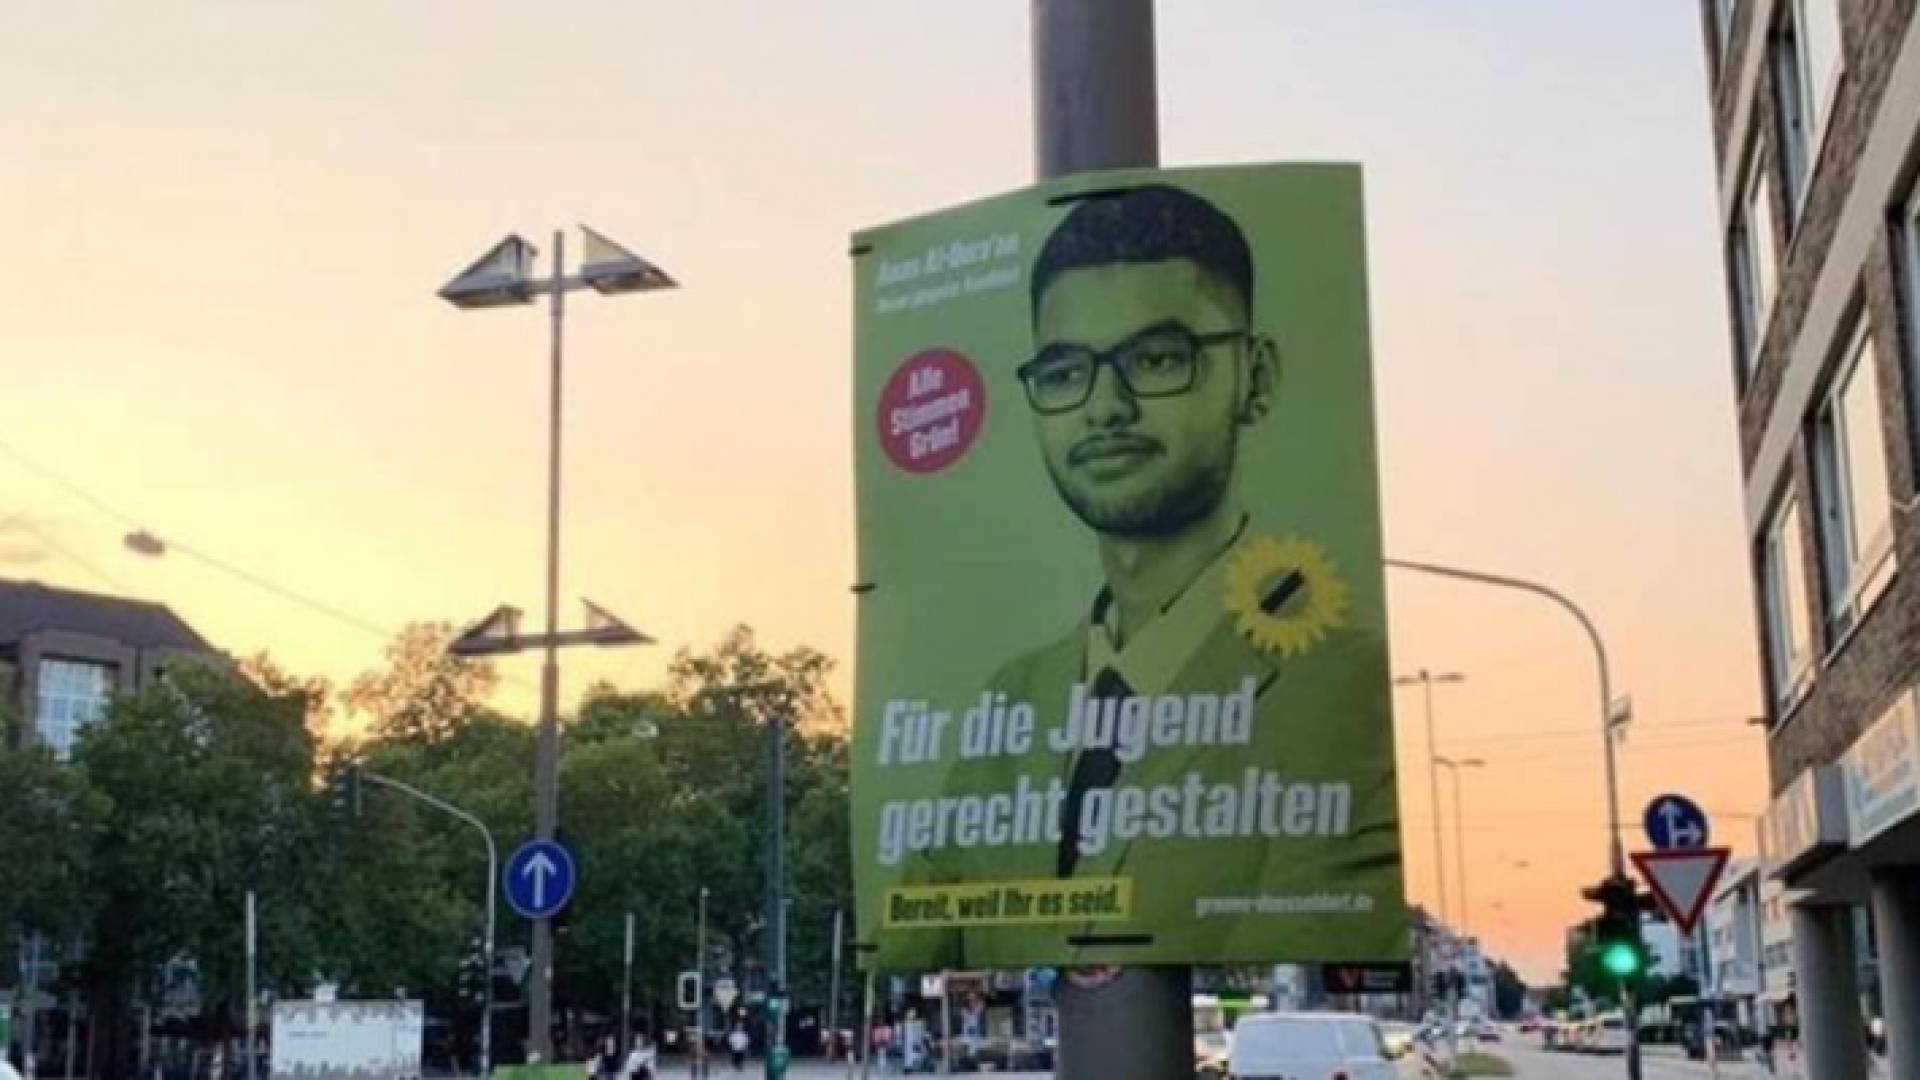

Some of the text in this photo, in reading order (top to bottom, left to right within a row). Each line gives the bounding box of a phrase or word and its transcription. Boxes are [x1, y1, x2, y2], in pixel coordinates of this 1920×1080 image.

[909, 366, 944, 399] Alle
[890, 388, 970, 436] Stimmen
[877, 676, 1257, 765] Für die Jugend
[878, 766, 1353, 865] gerecht gestalten
[958, 888, 1001, 918] weil
[1038, 892, 1065, 917] es
